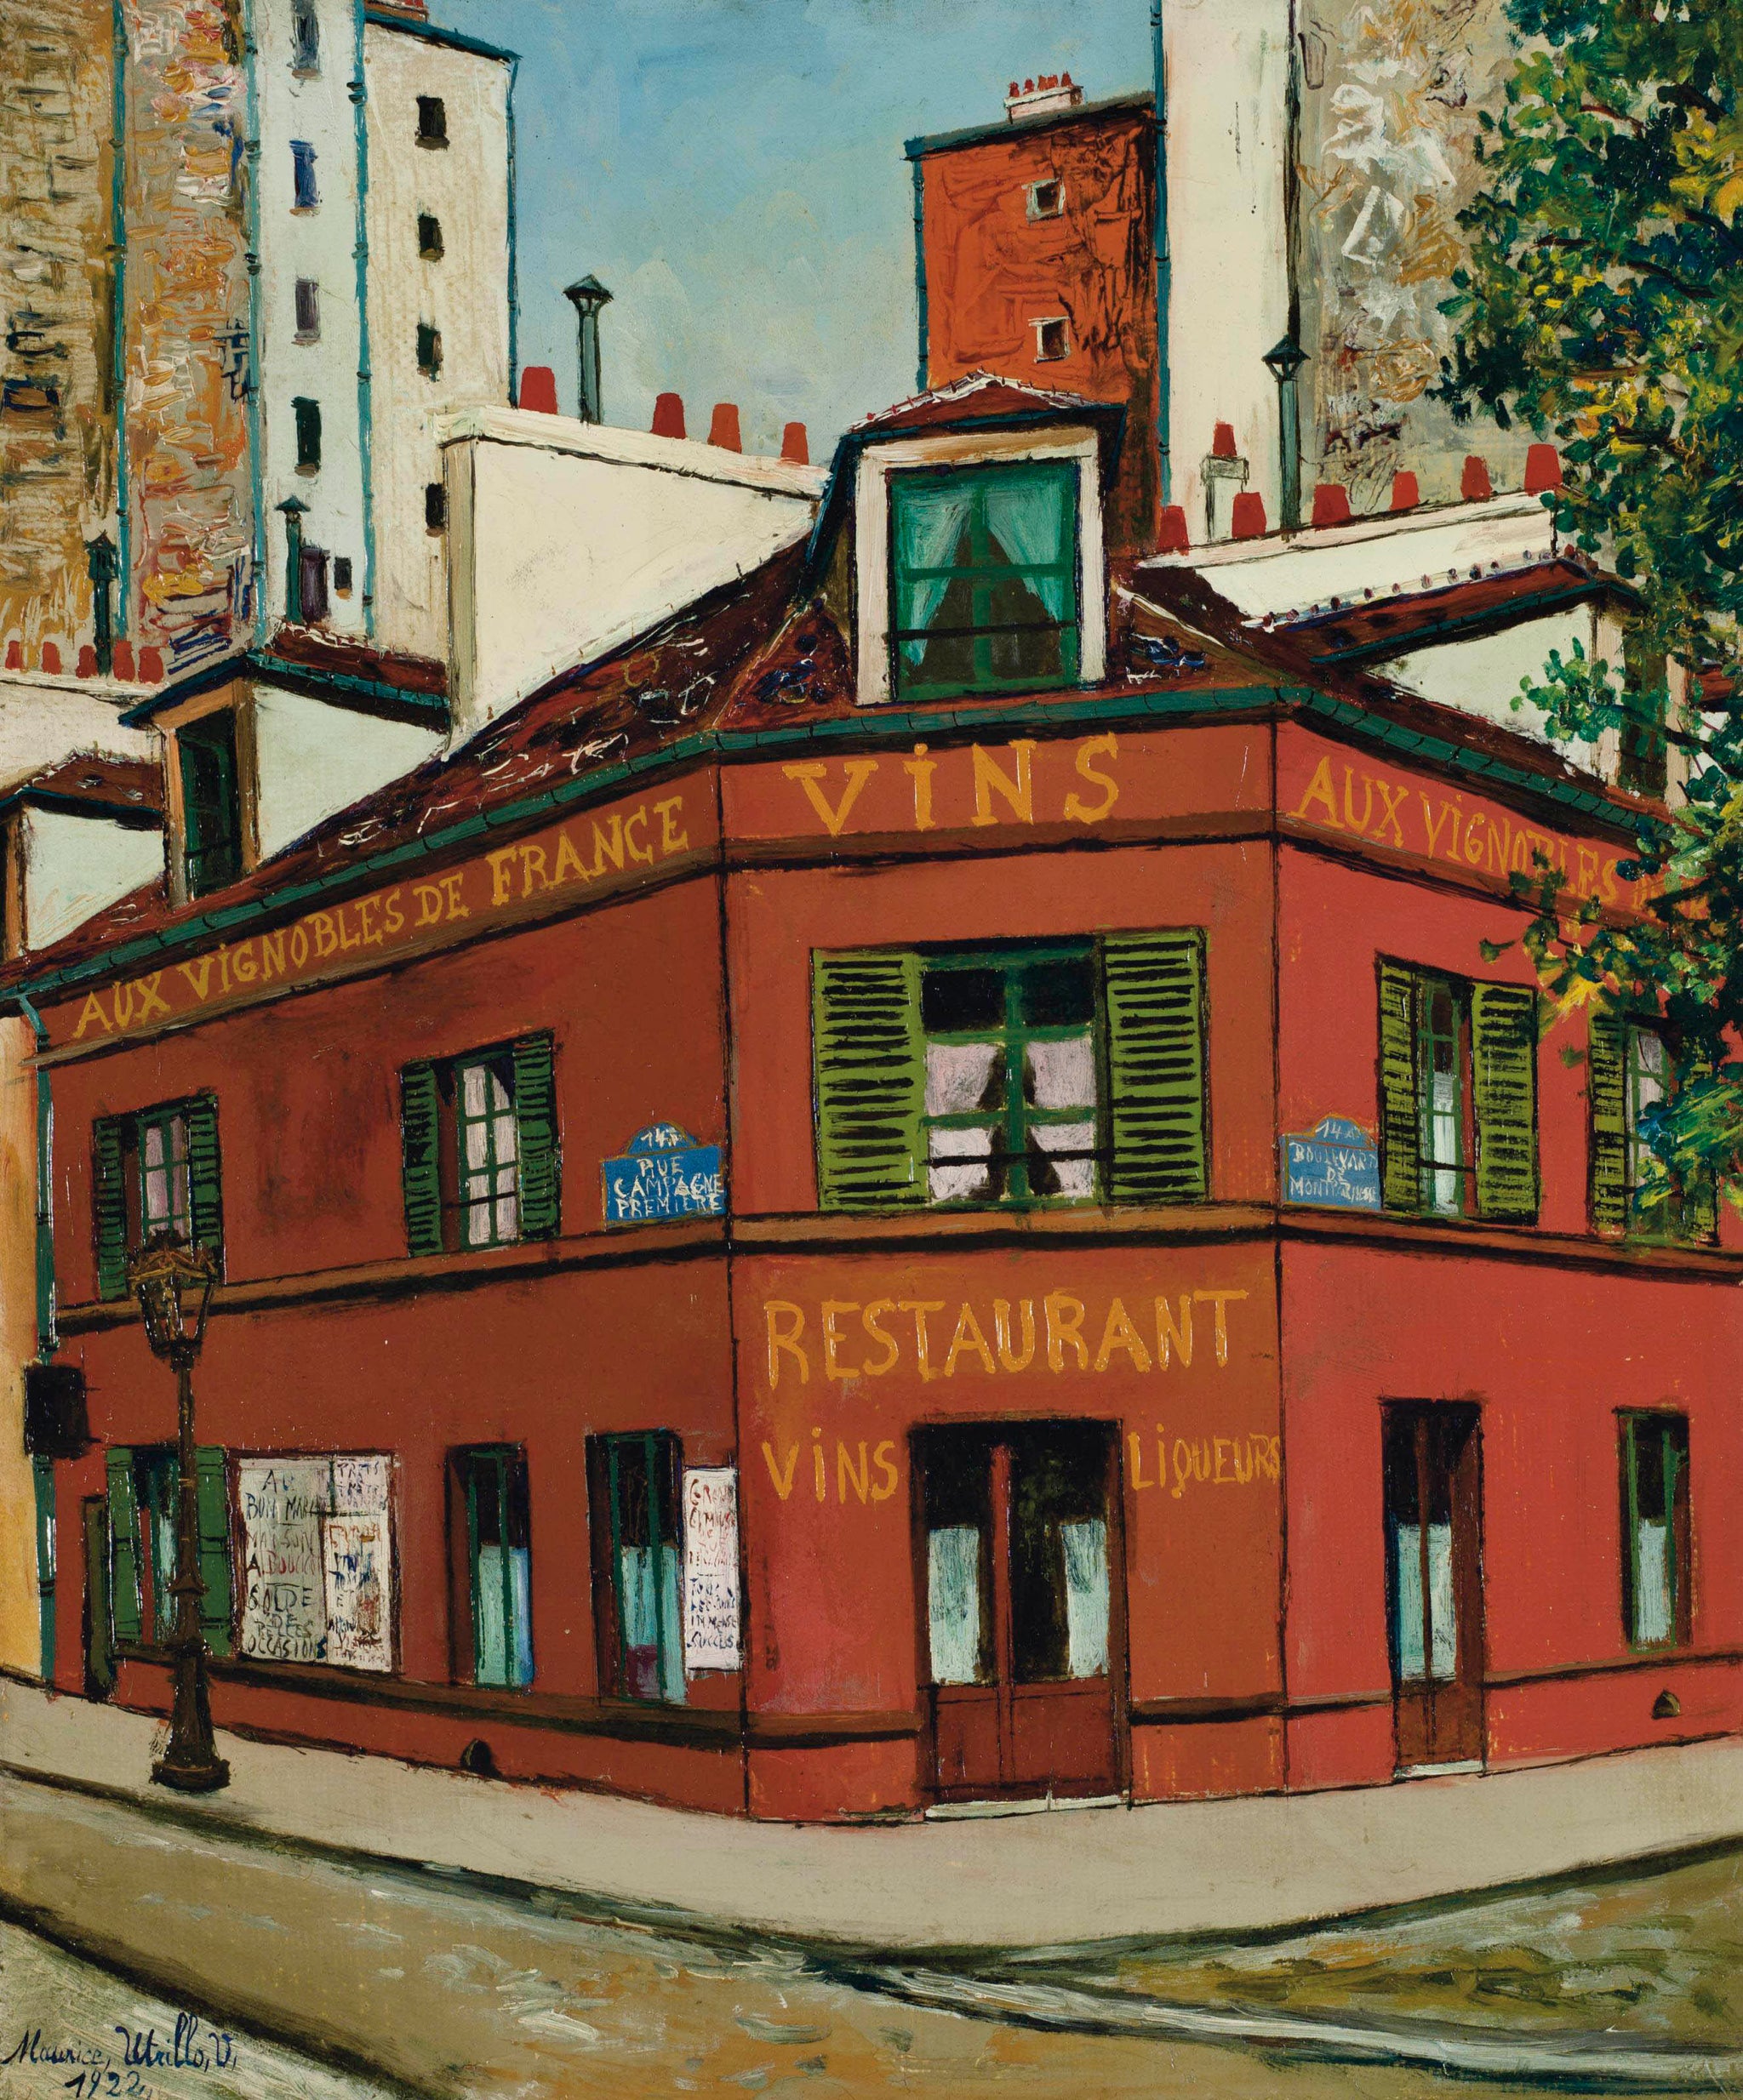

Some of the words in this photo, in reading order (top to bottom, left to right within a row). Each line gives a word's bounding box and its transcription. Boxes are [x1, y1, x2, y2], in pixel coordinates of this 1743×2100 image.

[1291, 755, 1409, 848] AUX
[72, 972, 170, 1038] AUX
[413, 873, 471, 927] DE
[485, 796, 688, 909] FRANCE
[614, 1172, 724, 1199] CAMPAGNE
[637, 1156, 684, 1178] RUE
[763, 1289, 1249, 1390] RESTAURANT
